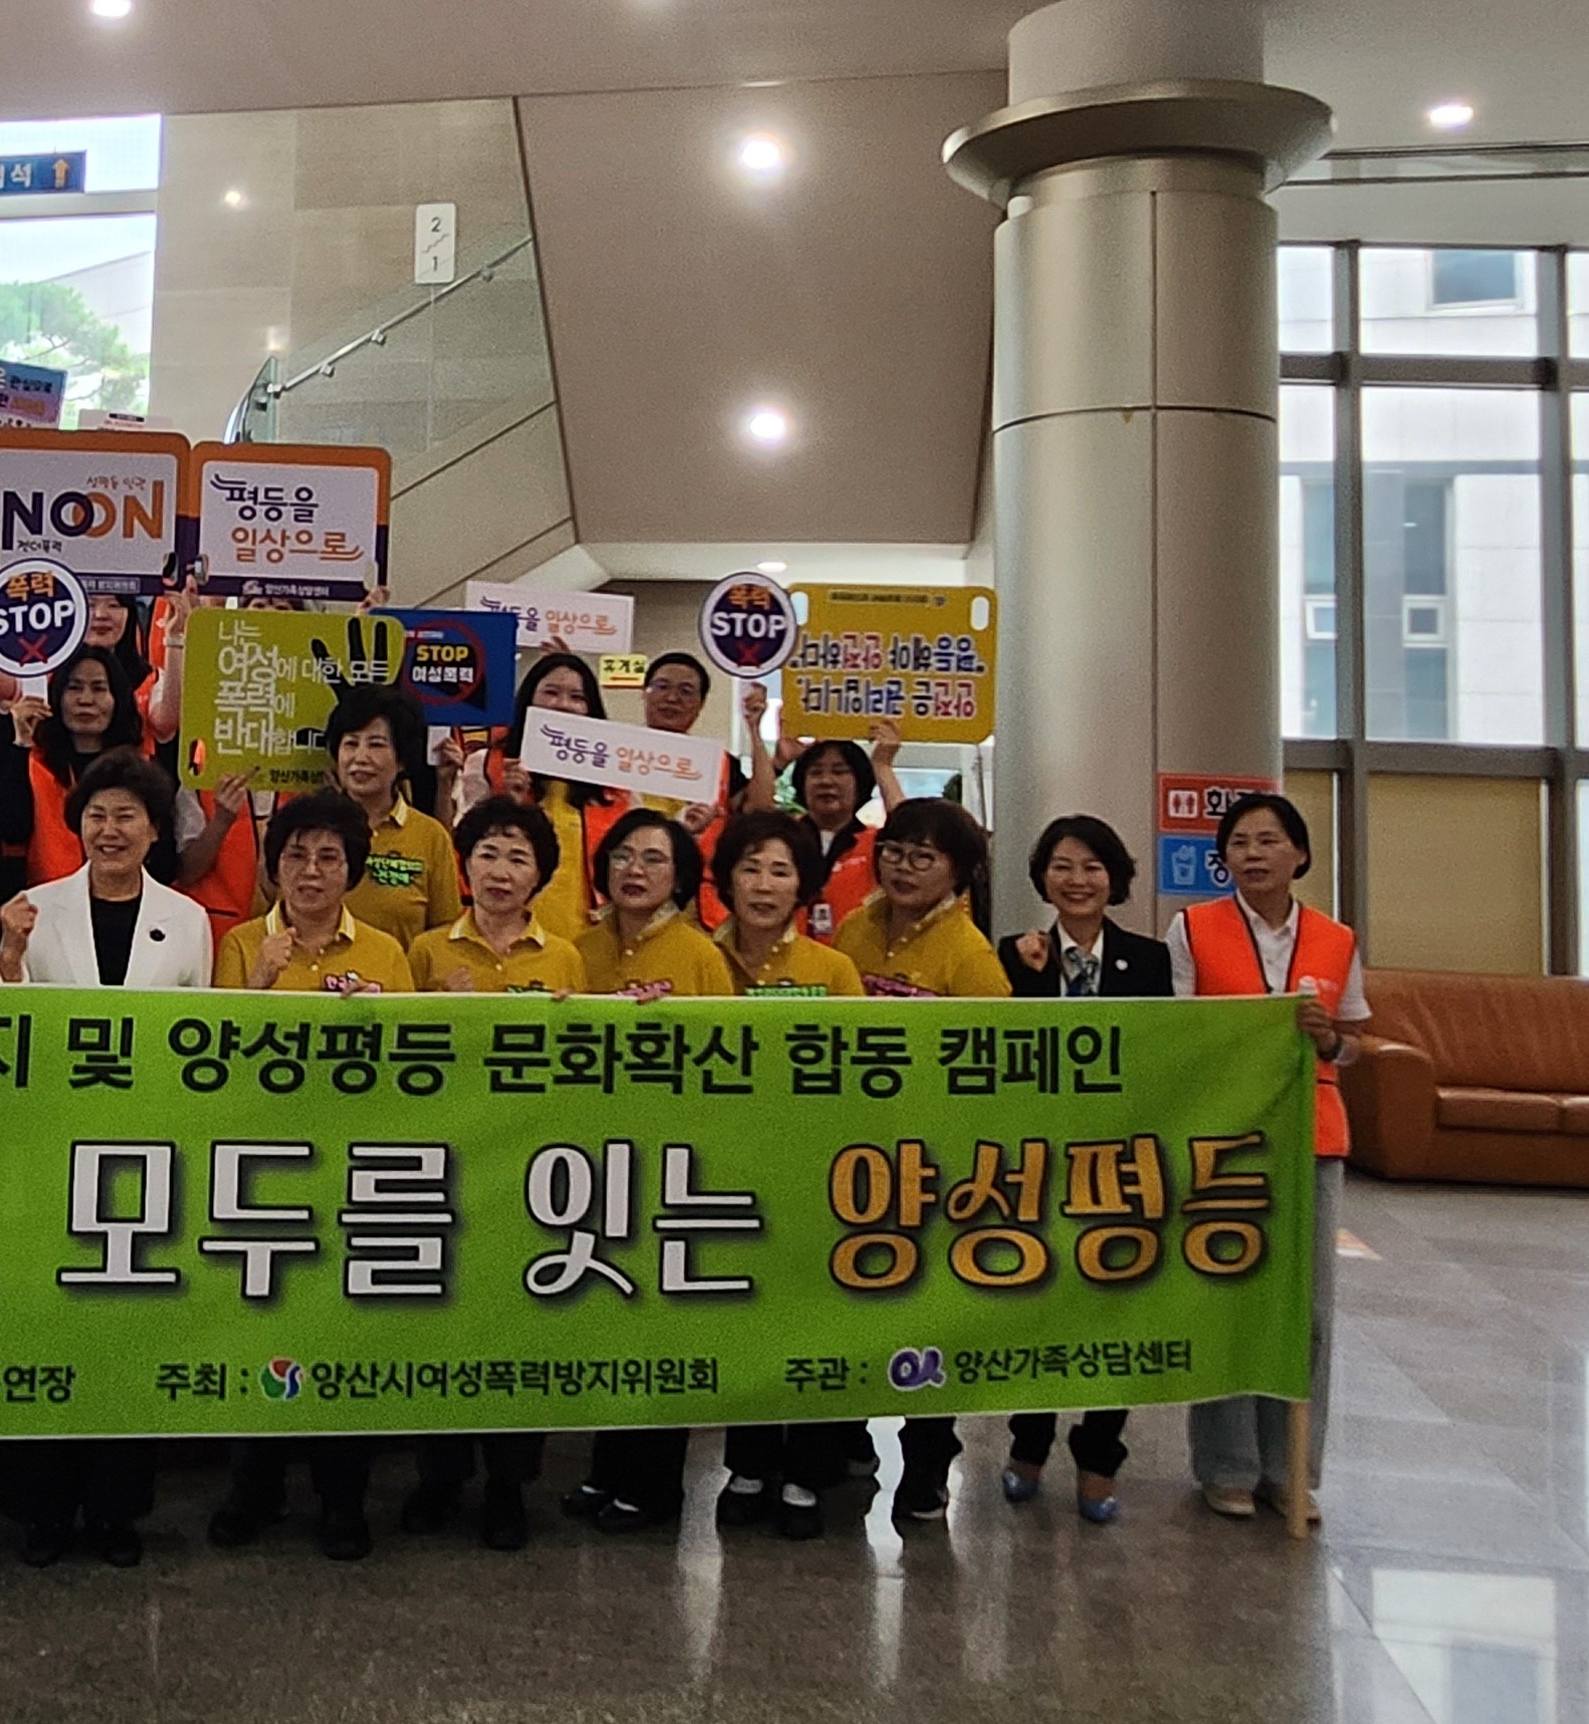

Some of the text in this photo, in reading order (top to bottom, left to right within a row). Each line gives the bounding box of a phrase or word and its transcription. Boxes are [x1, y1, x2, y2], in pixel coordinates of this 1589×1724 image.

[431, 217, 441, 232] 2
[432, 256, 439, 271] 1
[210, 473, 319, 524] 평등을
[231, 527, 364, 564] 일상으로
[5, 571, 54, 601] 폭력
[728, 584, 771, 610] 폭력
[218, 619, 262, 646] 나는
[545, 610, 617, 636] 일상으로
[712, 612, 786, 639] STOP
[218, 642, 297, 686] 여성에
[302, 656, 341, 684] 대한
[416, 645, 469, 661] STOP
[412, 666, 473, 683] 여성폭력
[214, 680, 295, 720] 폭력에
[797, 678, 976, 717] 안전은 권리입니다.
[540, 724, 702, 781] 평등을 일상으로
[65, 1015, 135, 1091] 및
[168, 1016, 456, 1097] 양성평등
[482, 1021, 760, 1097] 문화확산
[785, 1023, 912, 1099] 합동
[937, 1026, 1123, 1096] 캠페인
[53, 1139, 456, 1302] 모두를
[523, 1139, 764, 1301] 잇는
[827, 1130, 1271, 1292] 양성평등
[156, 1361, 228, 1401] 주최
[311, 1357, 719, 1400] 양산시여성폭력방지위원회
[784, 1357, 849, 1394] 주관
[955, 1338, 1193, 1384] 양산가족상담센터
